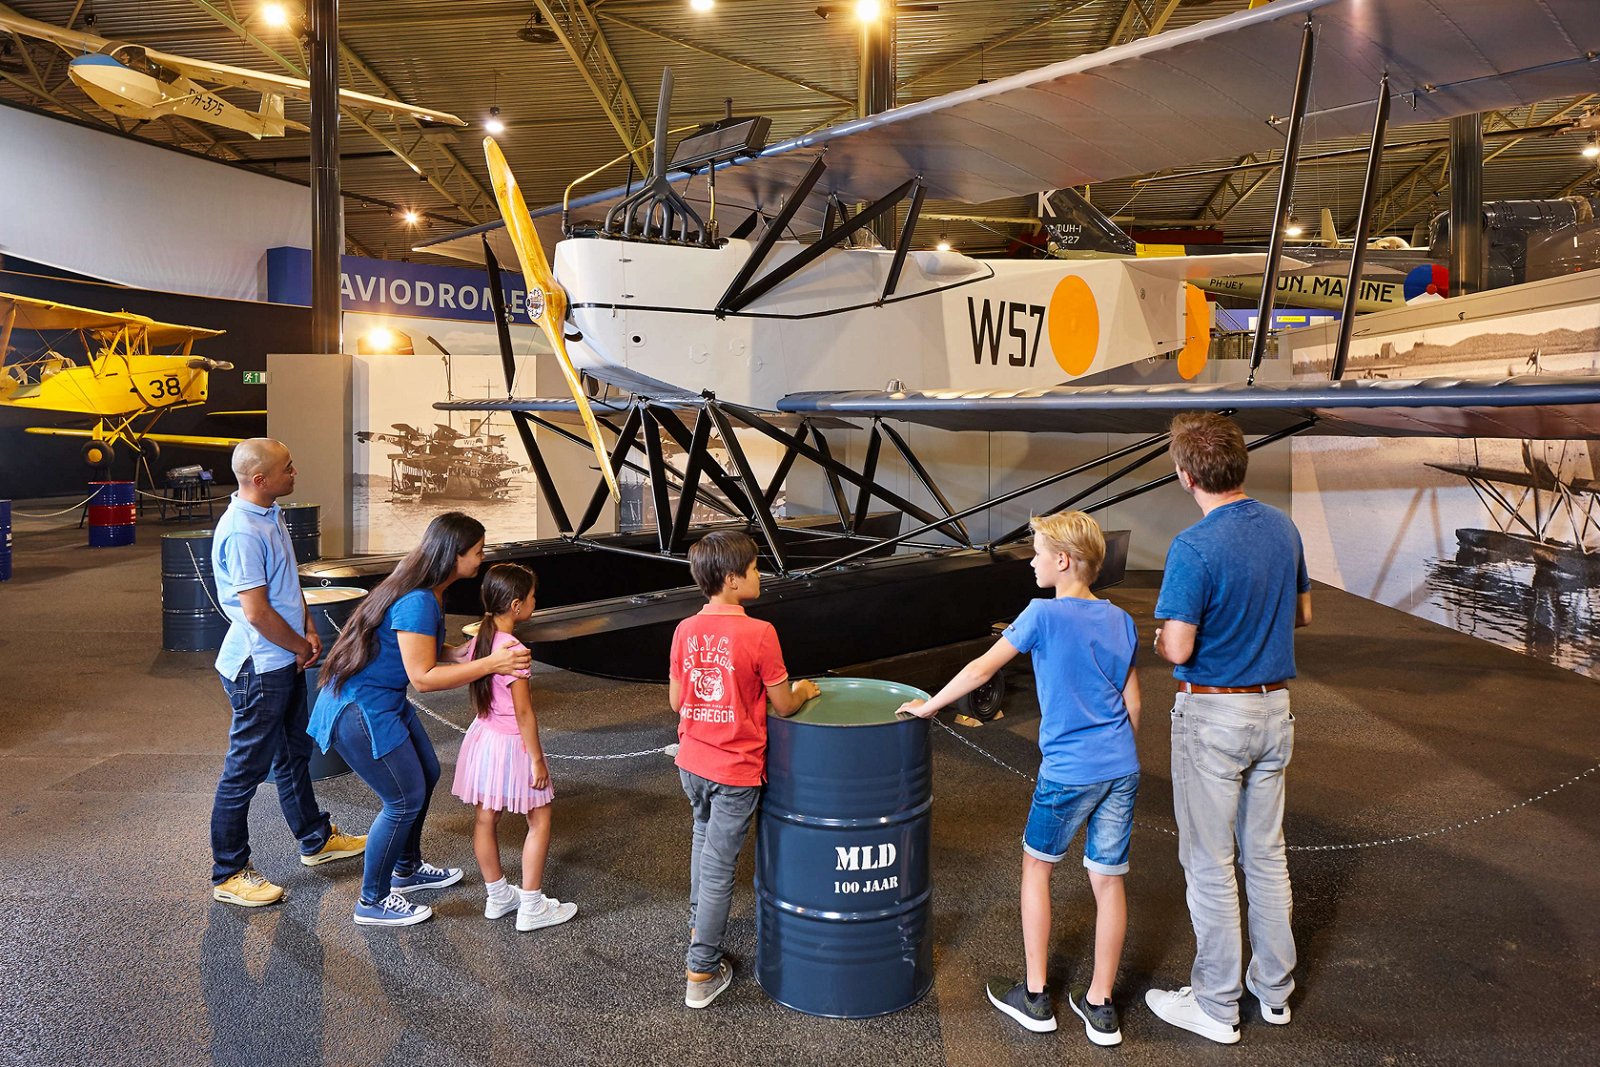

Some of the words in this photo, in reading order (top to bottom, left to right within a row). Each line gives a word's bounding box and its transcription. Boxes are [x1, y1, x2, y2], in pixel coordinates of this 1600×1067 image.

[1062, 235, 1080, 244] 227
[1312, 276, 1395, 302] MAINE
[967, 296, 1046, 367] W57
[149, 377, 181, 399] 38
[687, 634, 730, 656] N.Y.C.
[700, 652, 736, 675] LEAGUE
[835, 843, 897, 871] MLD
[834, 881, 860, 894] 100
[862, 876, 899, 893] JAAR
